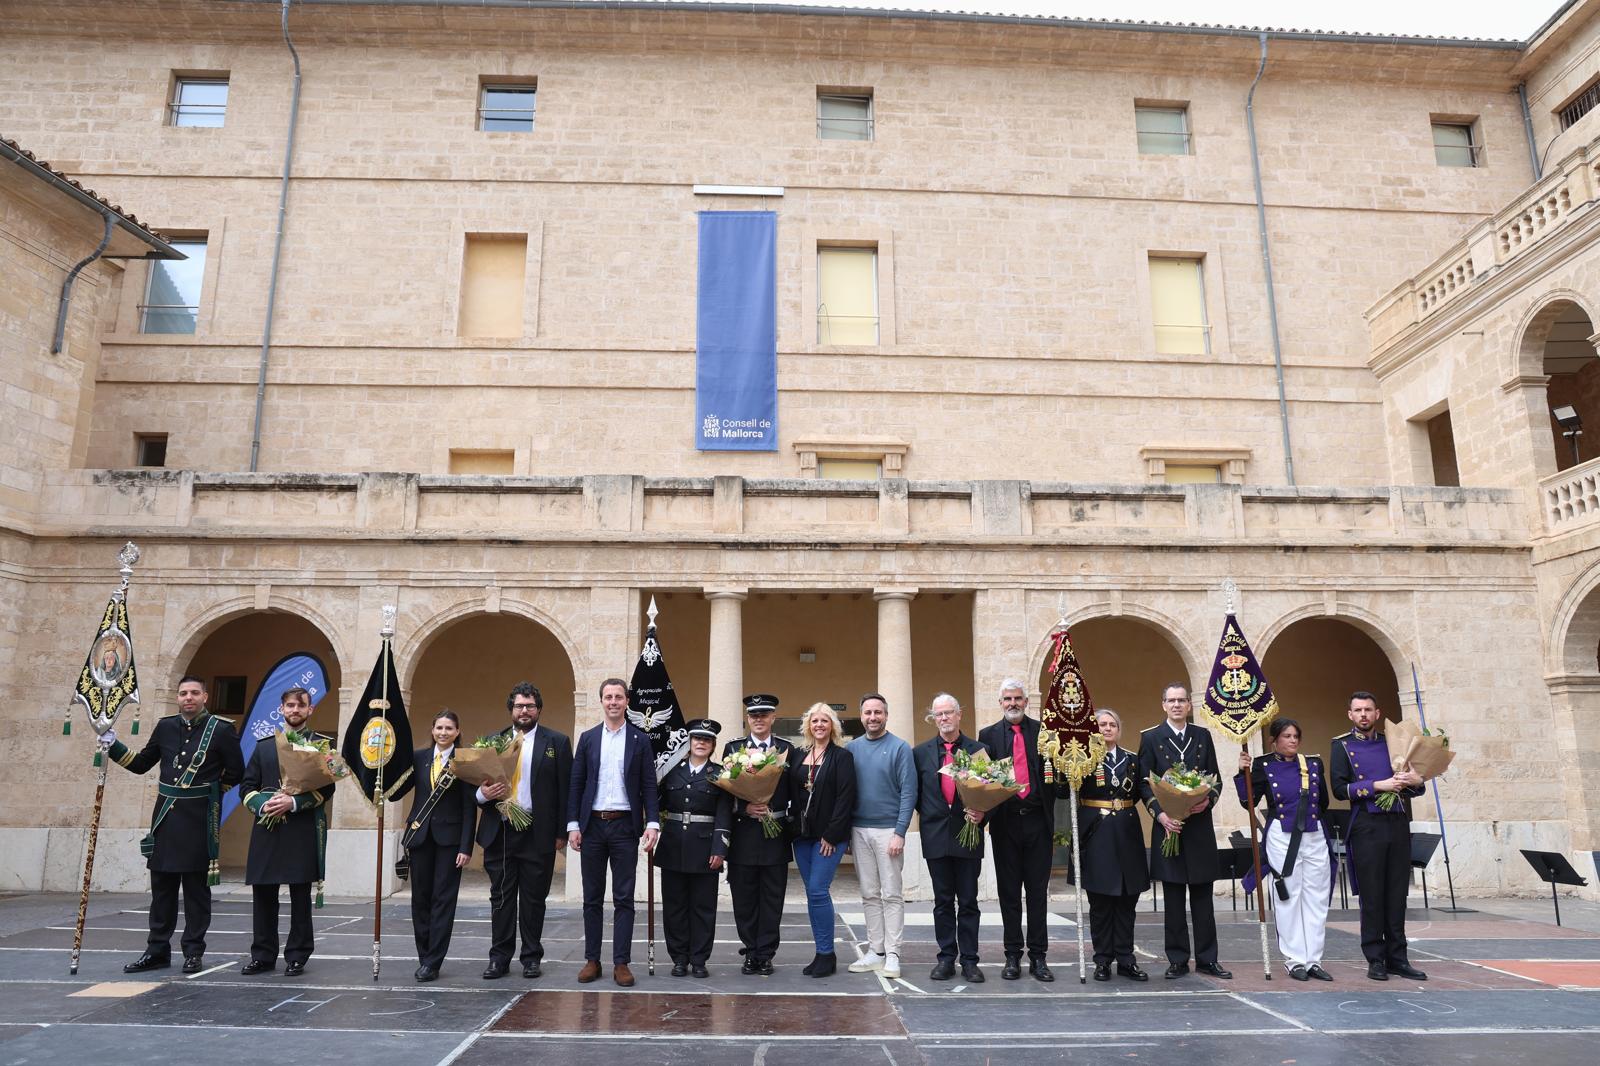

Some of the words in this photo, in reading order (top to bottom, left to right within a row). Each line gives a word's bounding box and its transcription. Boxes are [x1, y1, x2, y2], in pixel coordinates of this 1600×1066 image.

[722, 418, 757, 428] Consell
[759, 418, 771, 428] de
[722, 429, 763, 438] Mallorca
[301, 670, 314, 684] de
